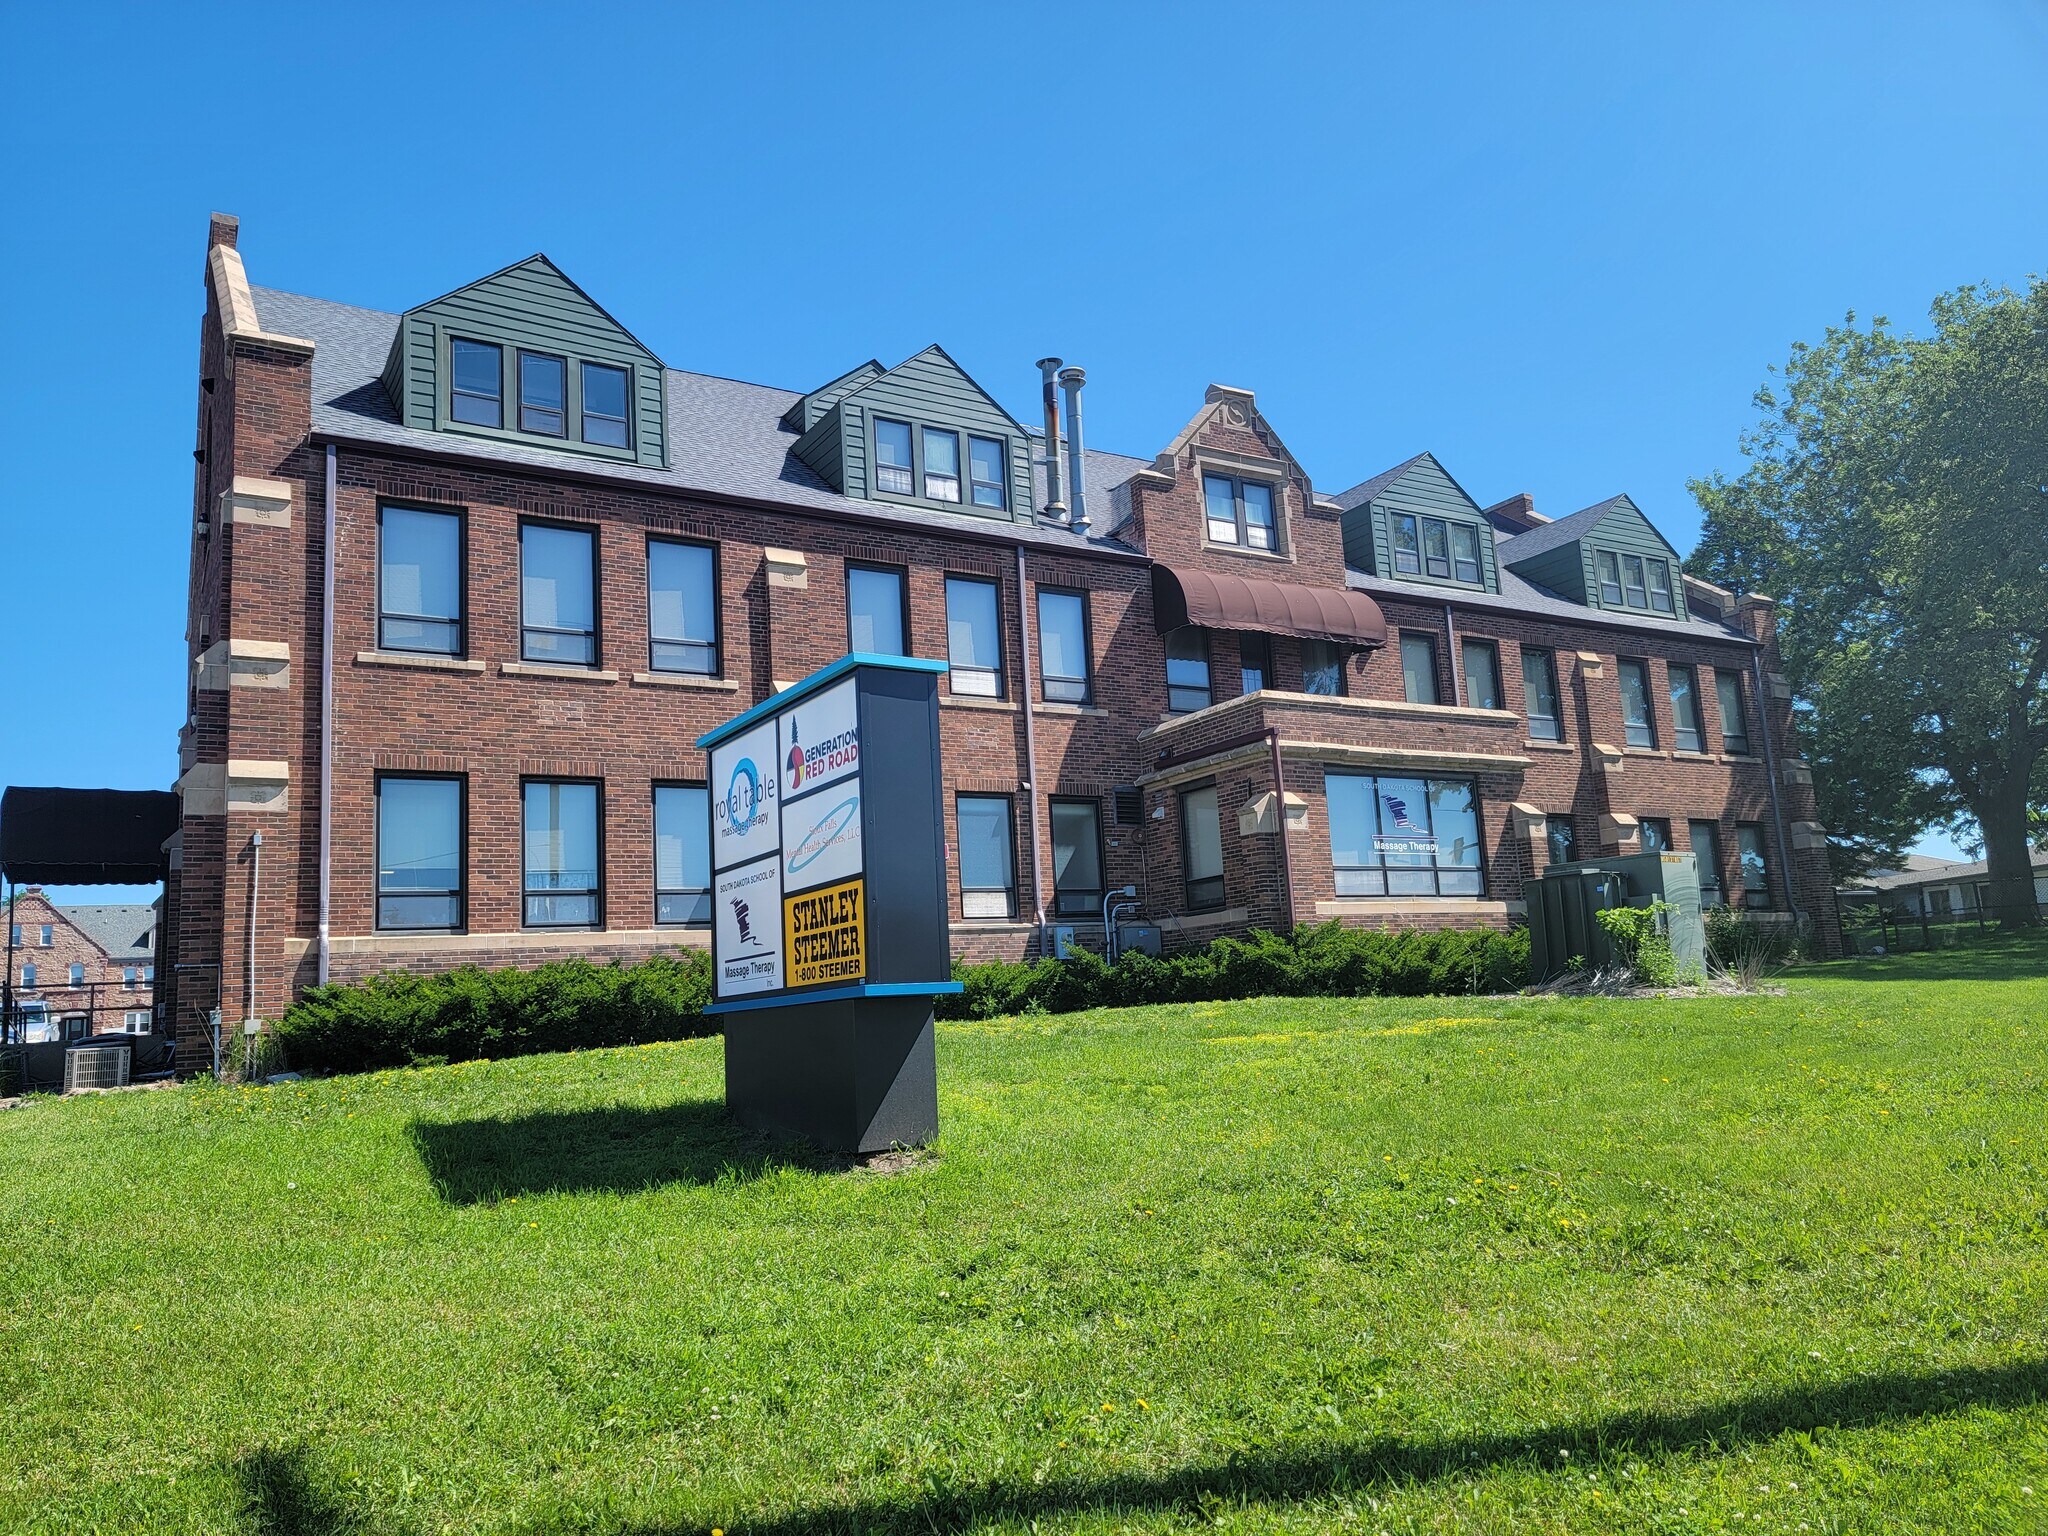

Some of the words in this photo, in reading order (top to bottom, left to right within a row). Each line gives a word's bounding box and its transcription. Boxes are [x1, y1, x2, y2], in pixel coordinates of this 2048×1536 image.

[805, 727, 858, 763] GENERATION
[806, 758, 825, 780] RED
[828, 744, 858, 771] ROAD
[715, 785, 741, 822] royal
[744, 773, 775, 808] table
[1362, 782, 1382, 790] SOUTH
[1383, 783, 1404, 791] DAKOTA
[824, 818, 837, 831] Falls
[804, 838, 821, 854] Health
[847, 826, 861, 840] LLC
[1373, 840, 1408, 852] Massage
[1409, 841, 1439, 853] Therapy
[750, 871, 768, 884] SCHOOL
[769, 868, 776, 879] OF
[793, 888, 858, 933] STANLEY
[794, 925, 860, 965] STEEMER
[725, 966, 750, 979] Massage
[750, 961, 775, 975] Therapy
[795, 966, 817, 982] 1-800
[819, 959, 861, 979] STEEMER
